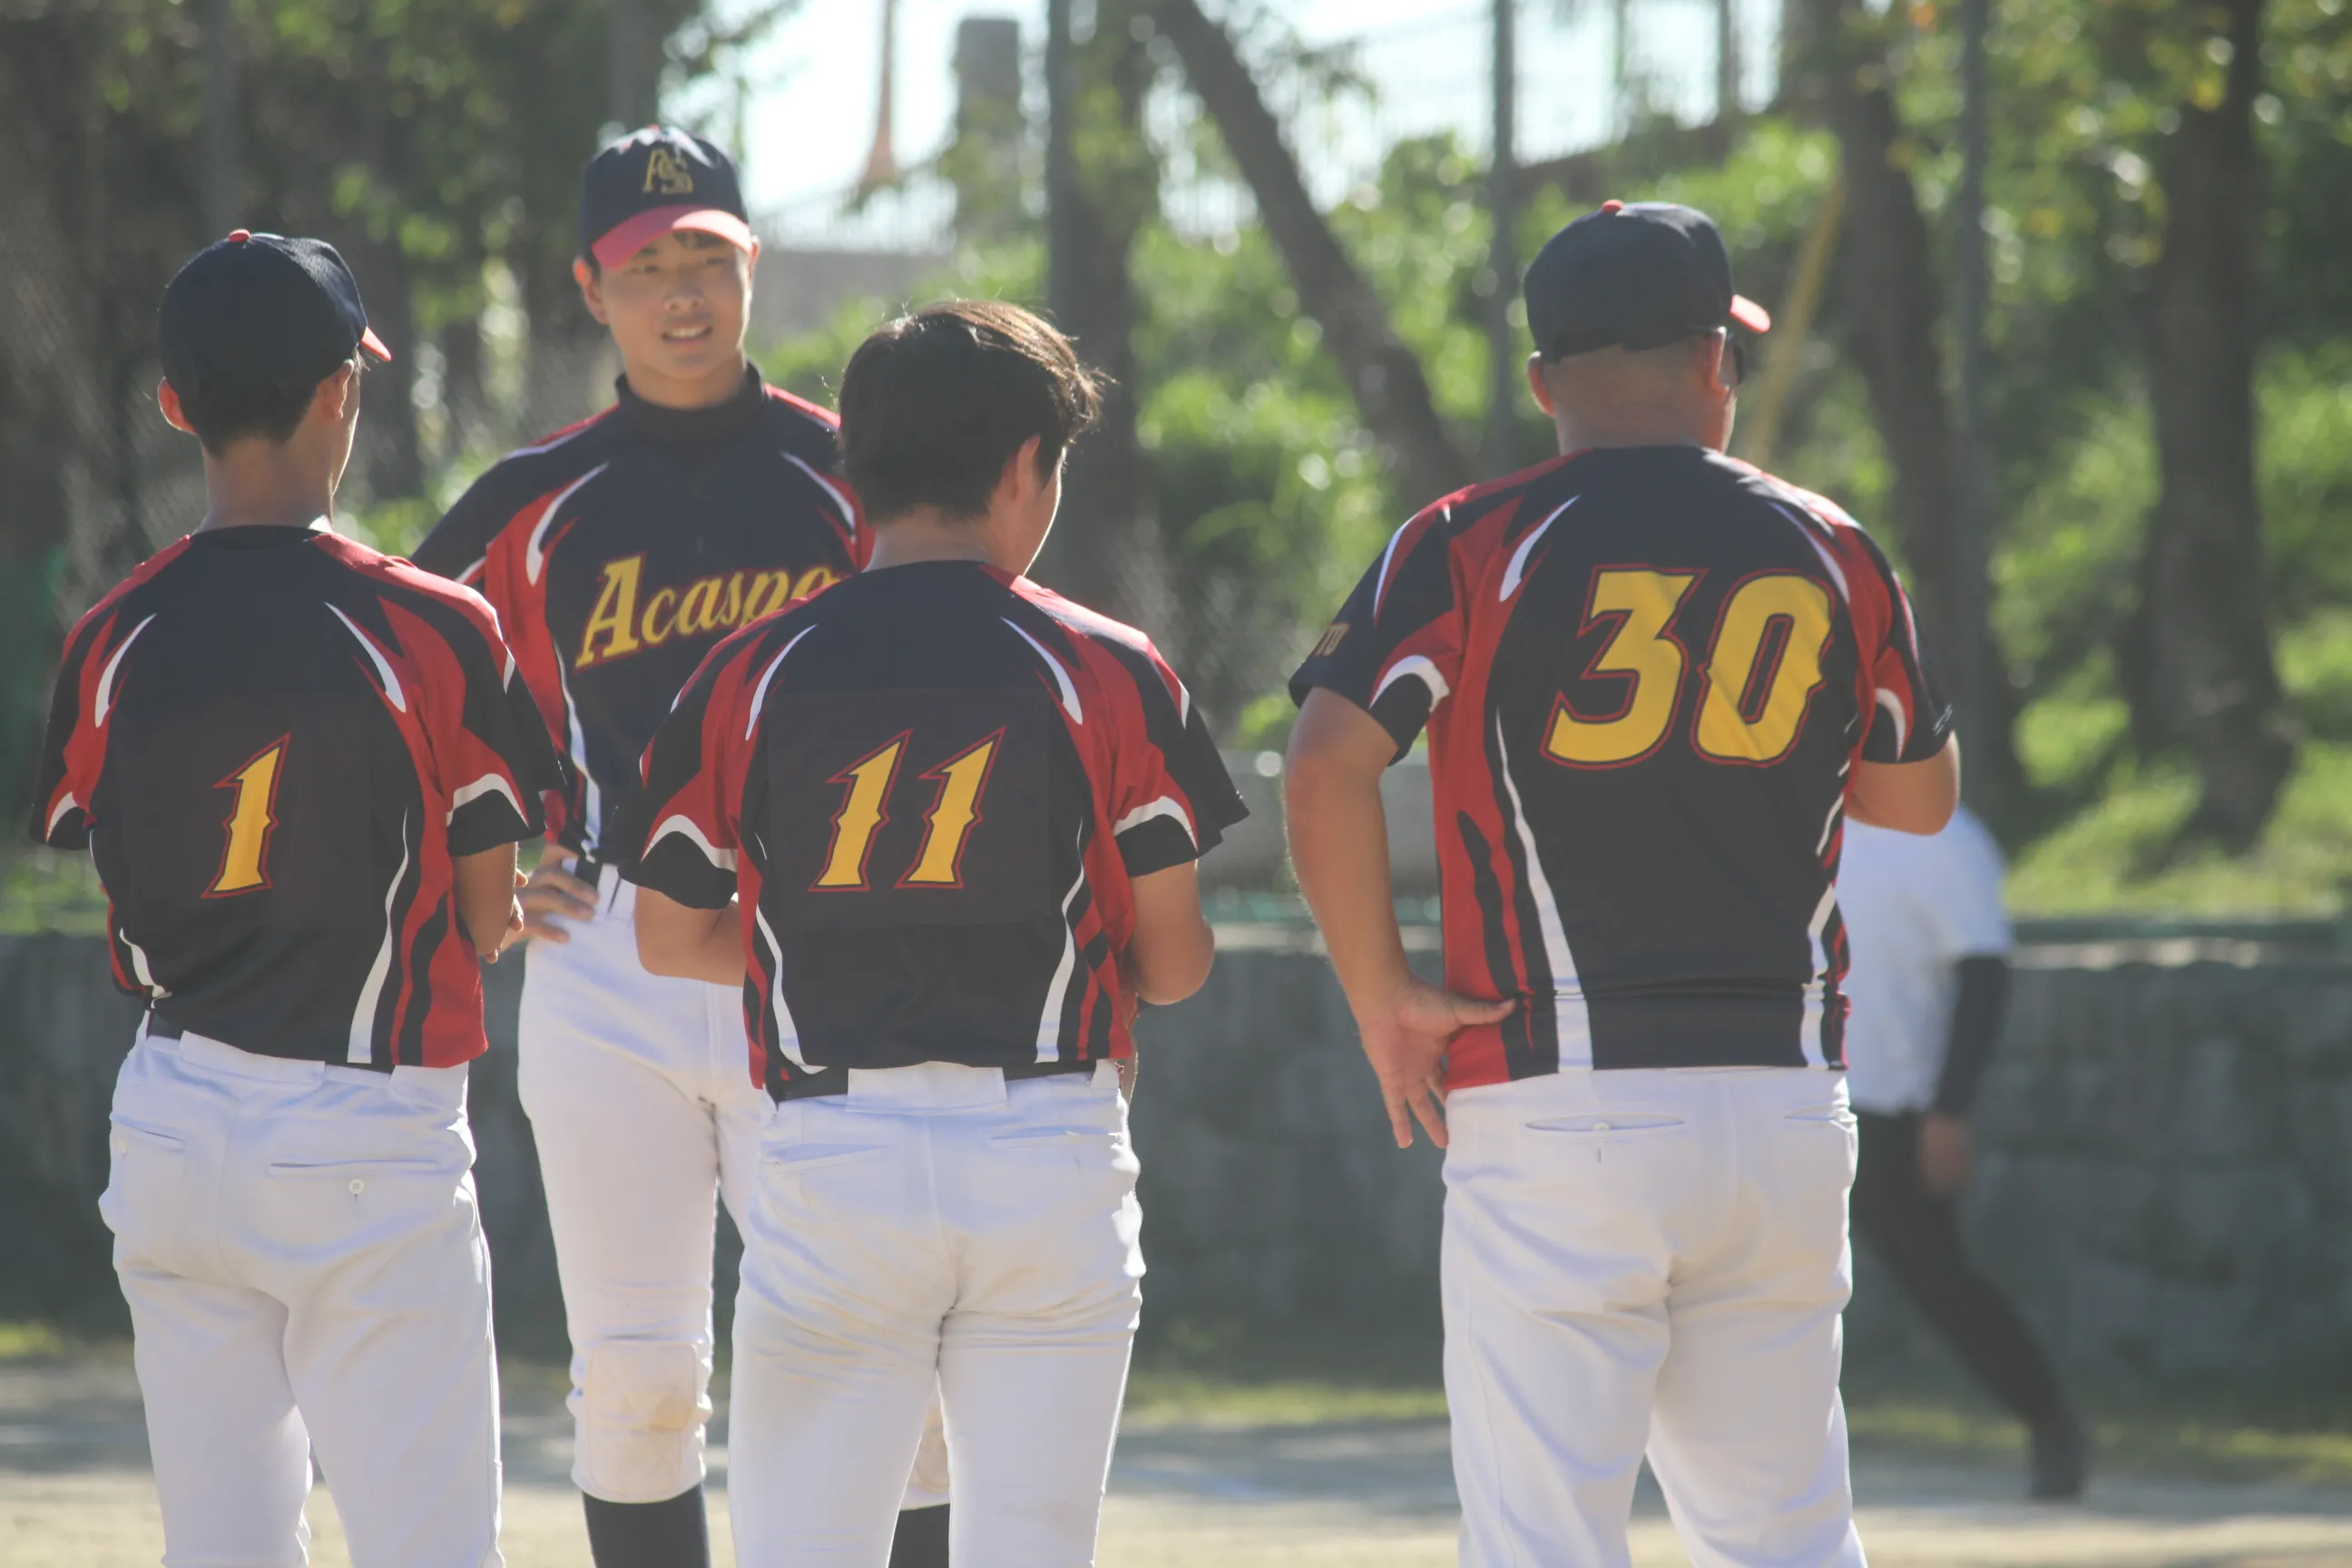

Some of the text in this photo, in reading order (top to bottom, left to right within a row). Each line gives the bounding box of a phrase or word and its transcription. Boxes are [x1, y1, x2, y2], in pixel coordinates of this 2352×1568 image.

[1541, 564, 1835, 768] 30
[204, 735, 289, 897] 1
[811, 730, 1003, 890] 11
